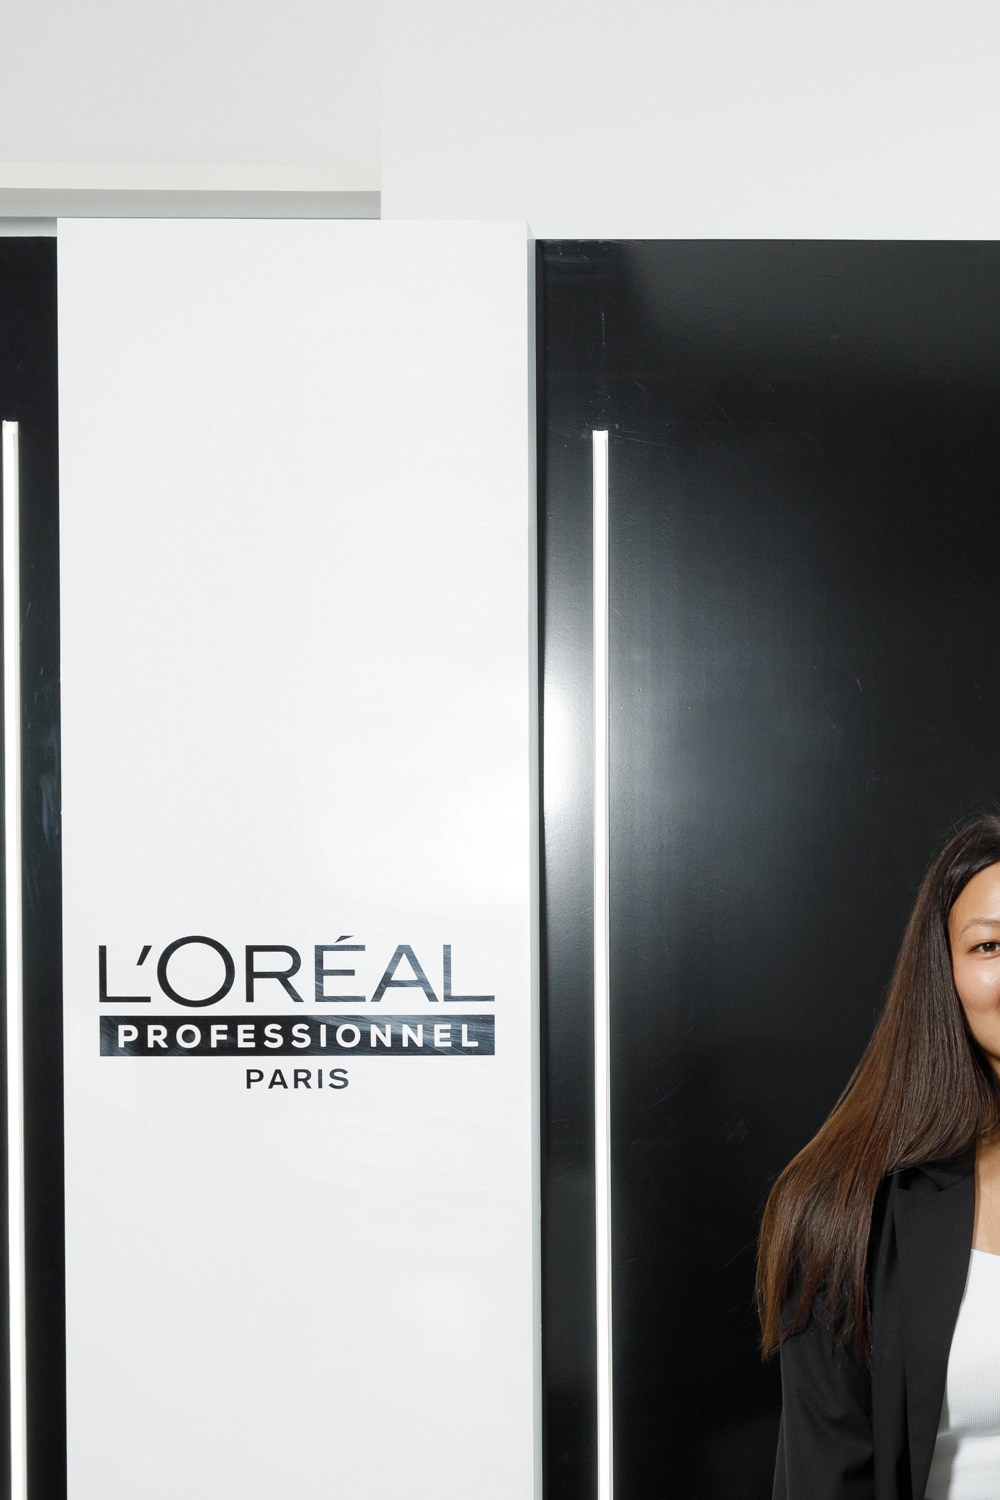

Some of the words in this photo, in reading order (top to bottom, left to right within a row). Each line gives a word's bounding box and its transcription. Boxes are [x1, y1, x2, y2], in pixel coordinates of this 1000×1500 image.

[98, 936, 496, 1008] L'ORÉAL
[117, 1023, 479, 1049] PROFESSIONNEL
[245, 1068, 350, 1090] PARIS
